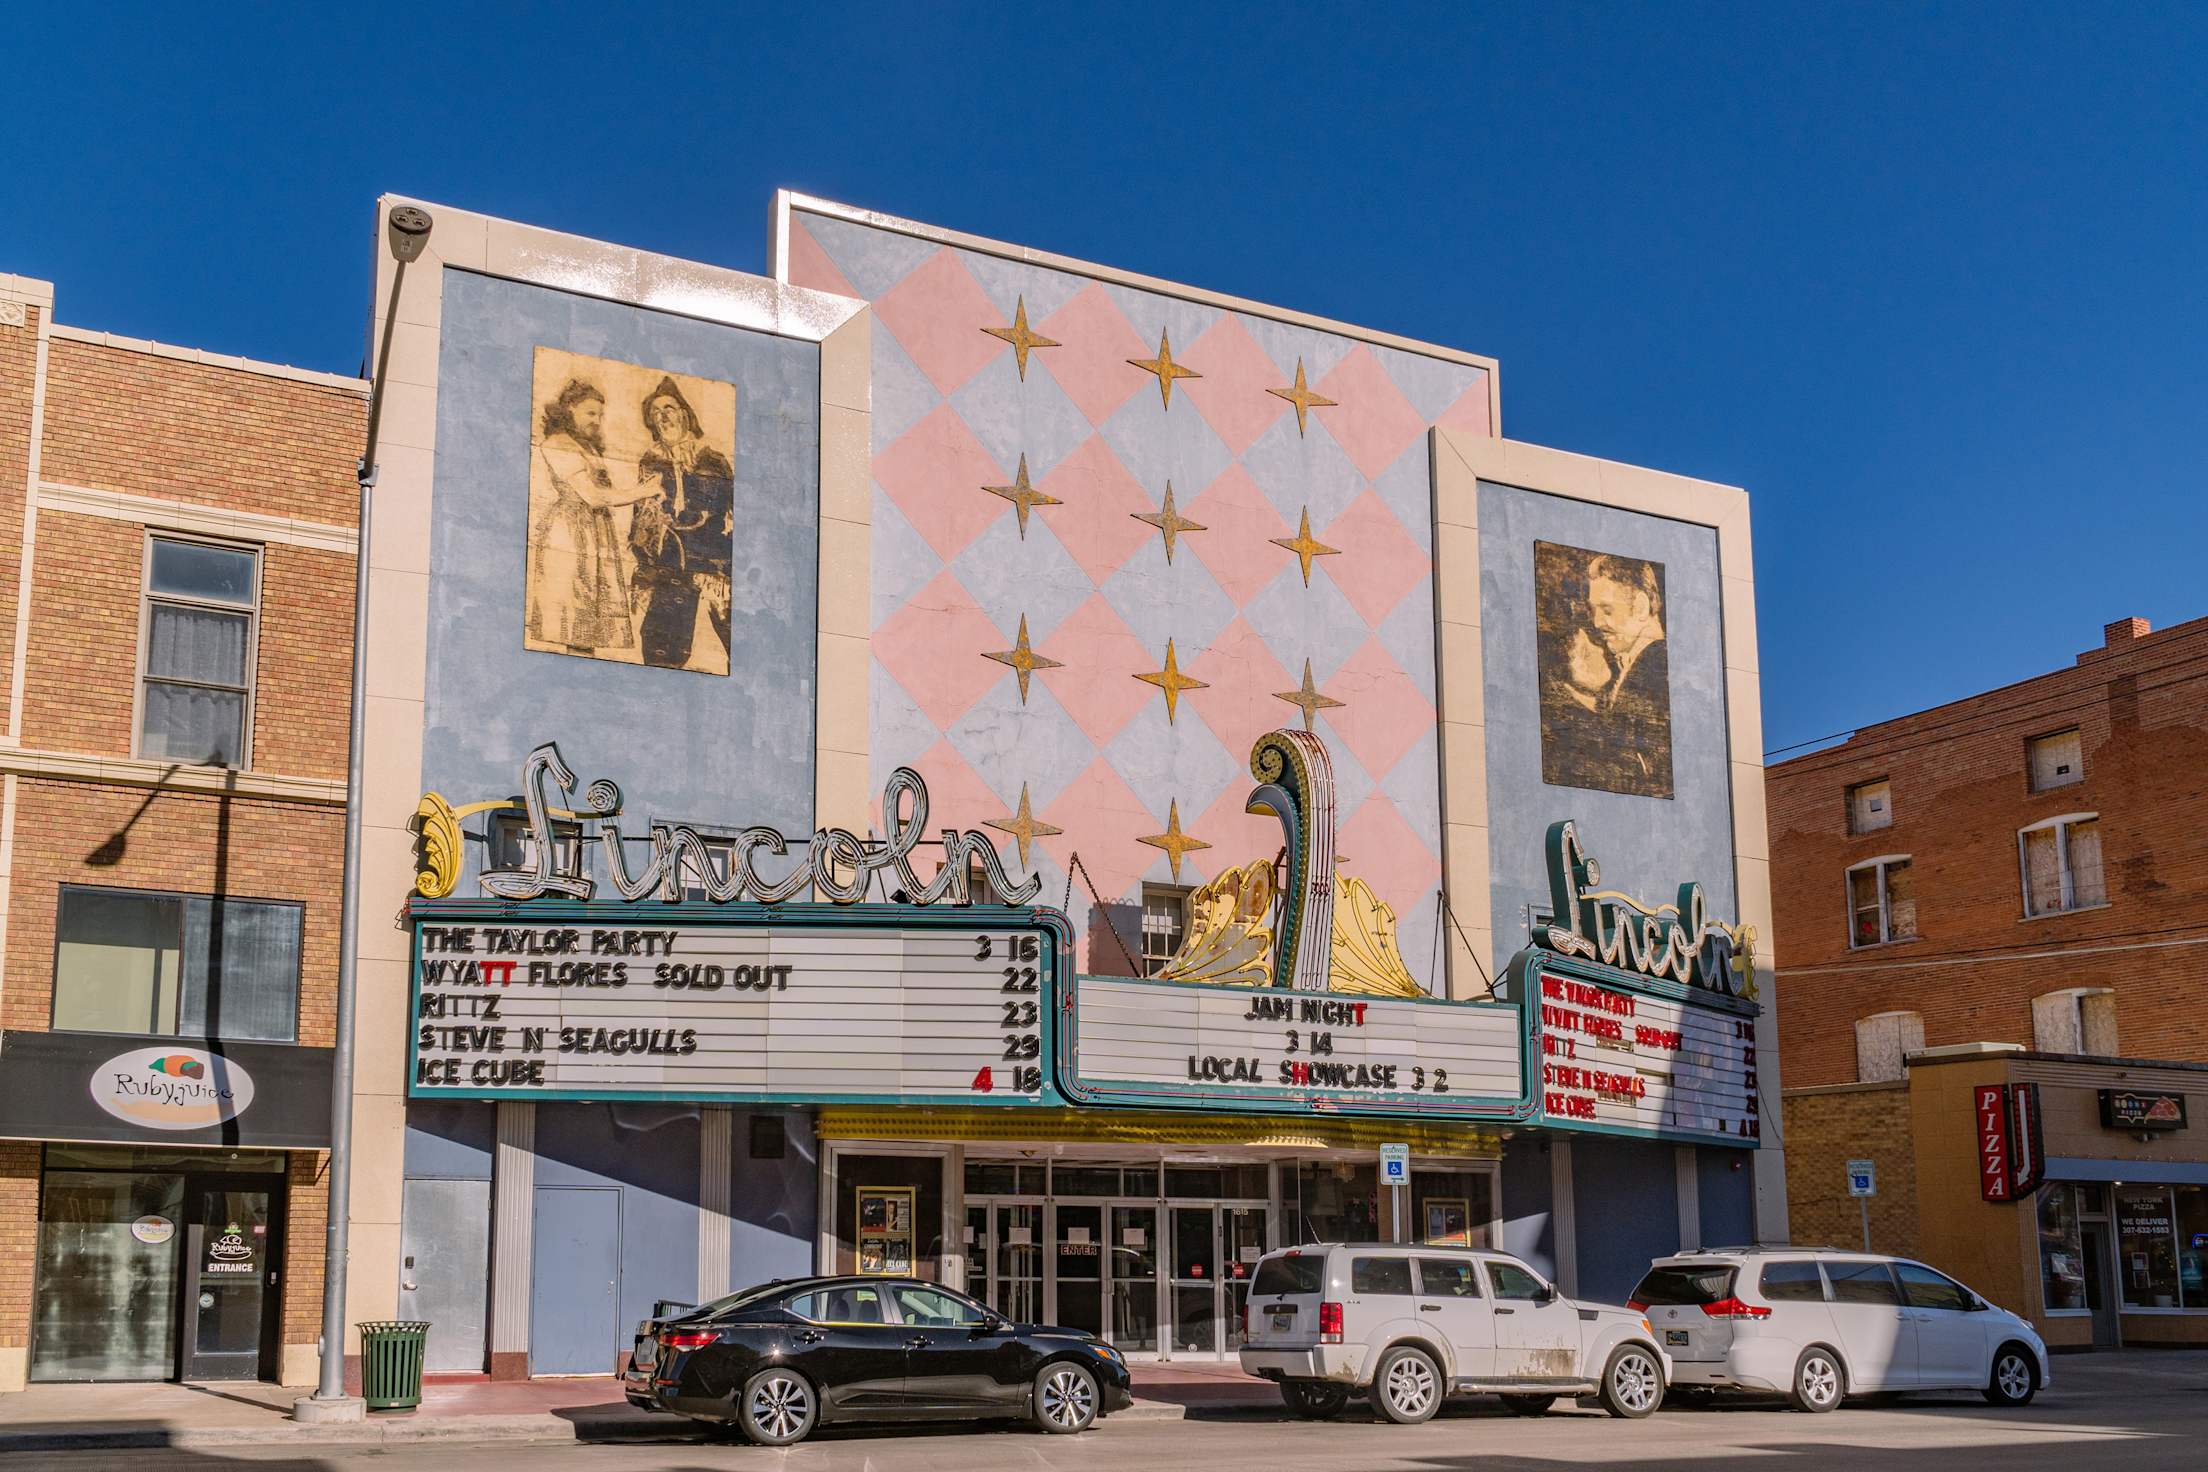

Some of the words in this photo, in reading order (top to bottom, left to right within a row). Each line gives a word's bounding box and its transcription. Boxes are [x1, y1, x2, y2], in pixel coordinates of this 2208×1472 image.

[478, 740, 1043, 906] Lincoln
[1531, 819, 1745, 996] Lincoln
[423, 927, 475, 953] THE
[484, 928, 580, 954] TAYLOR
[591, 930, 678, 956] PARTY
[974, 935, 992, 961] 3
[421, 960, 517, 986] WYATT
[528, 962, 628, 988] FLORES
[654, 963, 724, 990] SOLD
[734, 964, 792, 991] OUT
[1001, 967, 1039, 994] 22
[419, 994, 501, 1019] RITTZ
[1001, 1001, 1038, 1028] 23
[1244, 997, 1294, 1022] JAM
[1301, 999, 1368, 1027] NIGHT
[418, 1025, 506, 1052] STEVE
[558, 1027, 698, 1055] SEAGULLS
[1002, 1034, 1040, 1061] 29
[1285, 1030, 1299, 1054] 3
[1310, 1031, 1333, 1056] 14
[417, 1058, 461, 1085] ICE
[471, 1059, 545, 1086] CUBE
[972, 1066, 993, 1093] 4
[1012, 1066, 1041, 1093] 18
[1188, 1055, 1262, 1083] LOCAL
[1278, 1060, 1397, 1089] SHOWCASE
[1411, 1066, 1424, 1091] 3
[1433, 1068, 1449, 1092] 2
[114, 1073, 234, 1105] Rubyjuice
[1981, 1092, 2004, 1196] PIZZA
[1061, 1244, 1098, 1256] ENTER
[208, 1263, 253, 1272] ENTRANCE
